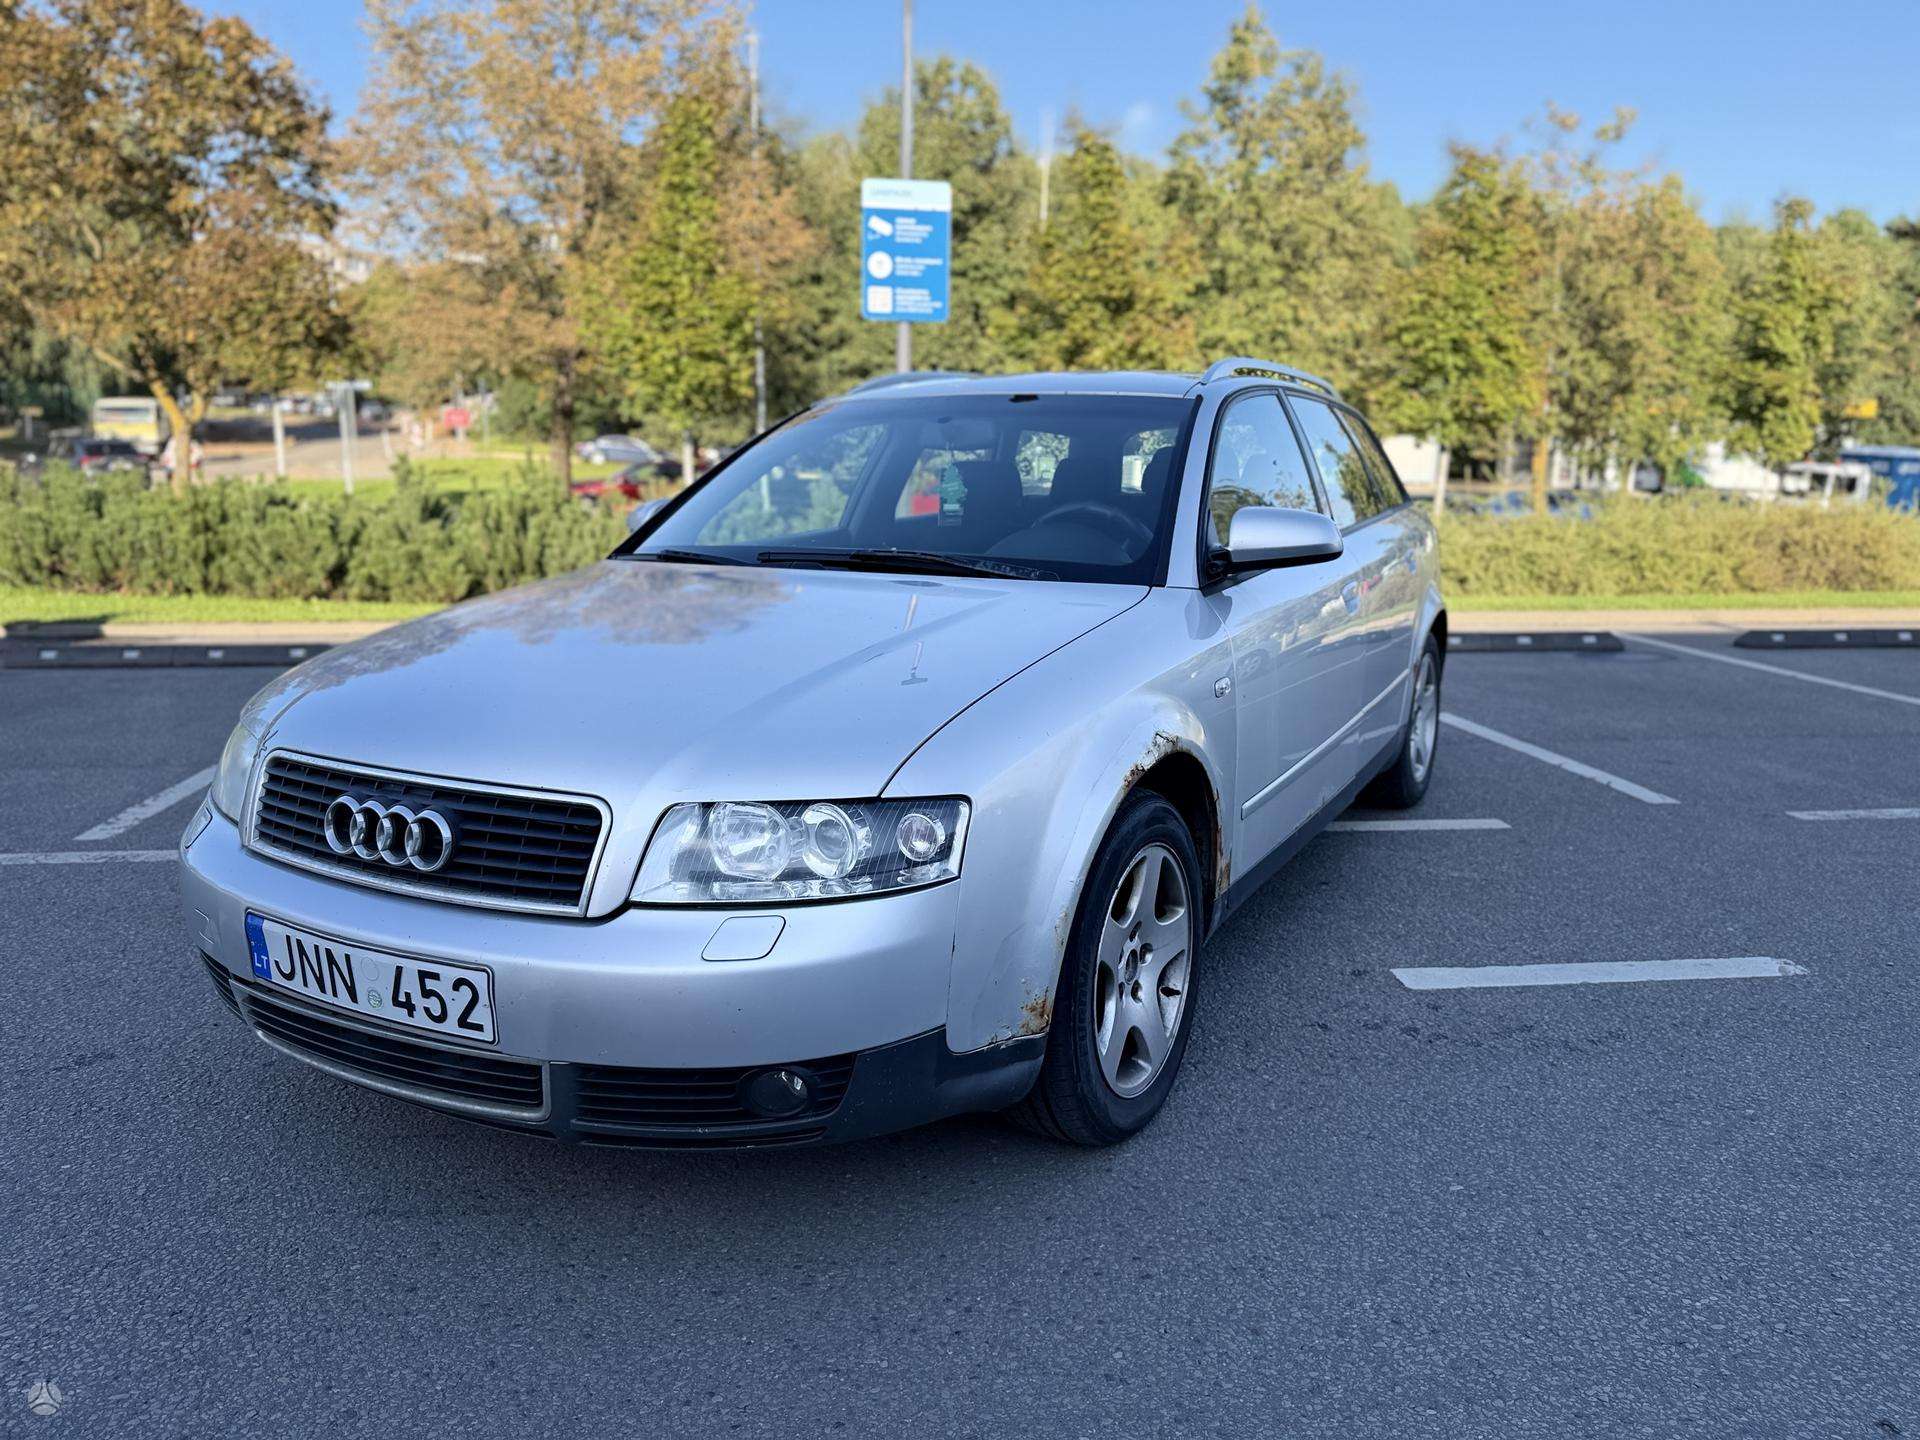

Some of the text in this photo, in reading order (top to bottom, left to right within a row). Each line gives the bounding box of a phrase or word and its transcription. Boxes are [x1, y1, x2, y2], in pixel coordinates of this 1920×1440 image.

[253, 952, 269, 970] LT
[274, 934, 485, 1033] JNN 452
